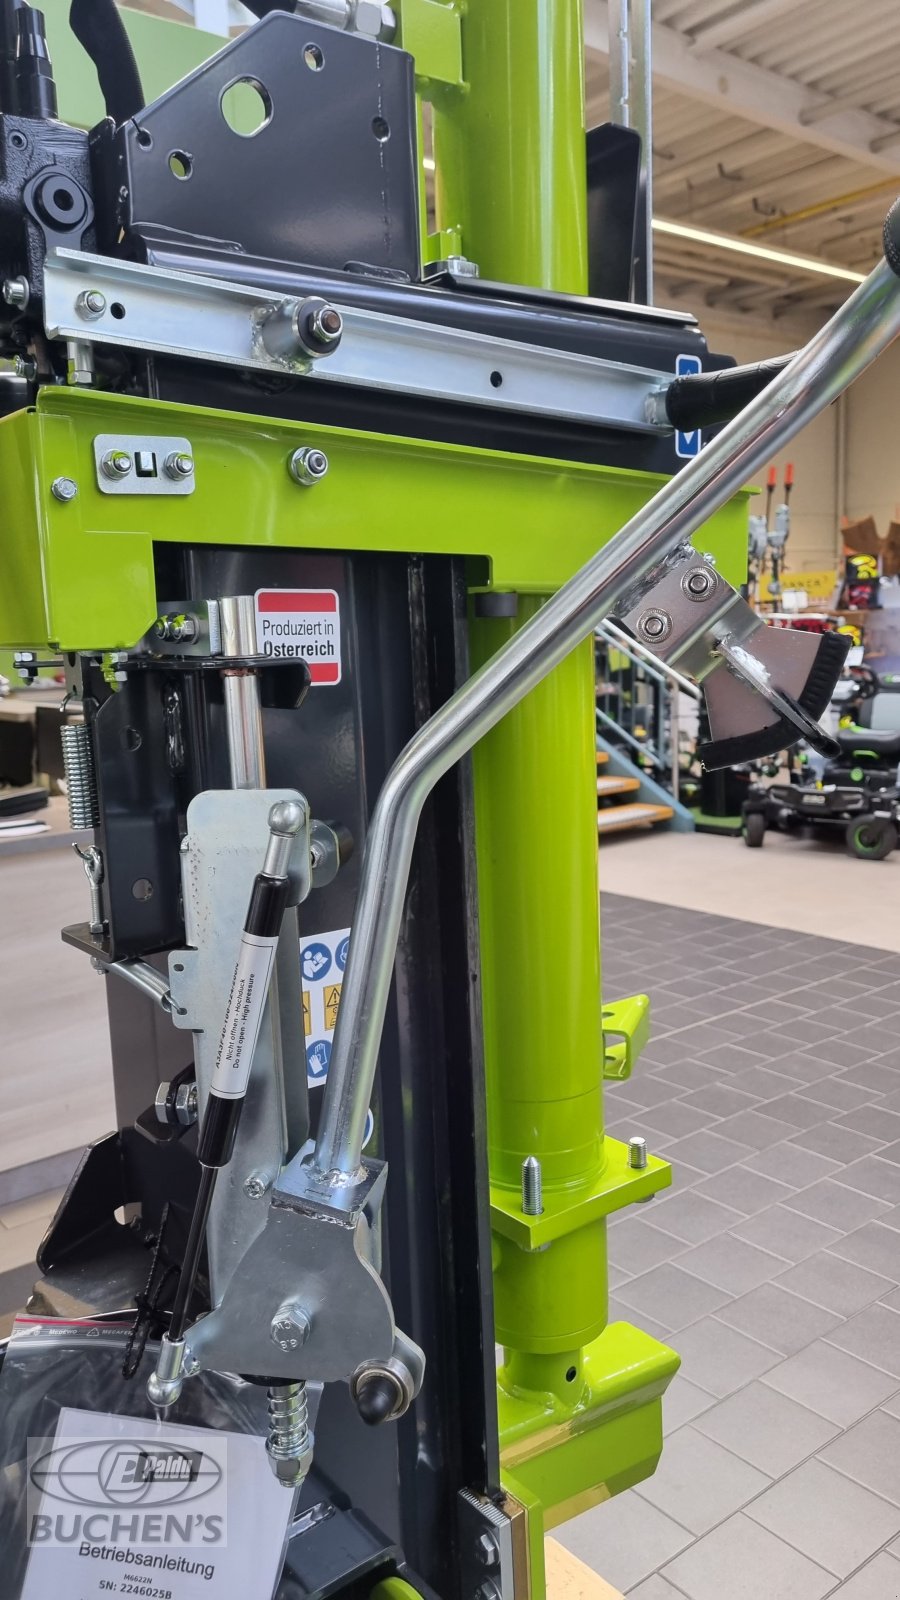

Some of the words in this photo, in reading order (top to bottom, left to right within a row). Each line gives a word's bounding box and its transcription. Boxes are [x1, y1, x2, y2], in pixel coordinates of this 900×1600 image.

[262, 619, 322, 636] Produziert
[324, 619, 334, 635] in
[263, 640, 335, 657] Österreich
[245, 973, 255, 1004] pressure
[241, 1004, 251, 1021] High
[238, 1026, 246, 1045] open
[225, 1042, 235, 1061] Nicht
[232, 1058, 240, 1069] Do
[78, 1541, 215, 1581] Betriebsanleitung
[123, 1573, 153, 1585] M6622N
[98, 1579, 117, 1591] SN:
[120, 1583, 172, 1600] 2246025B
